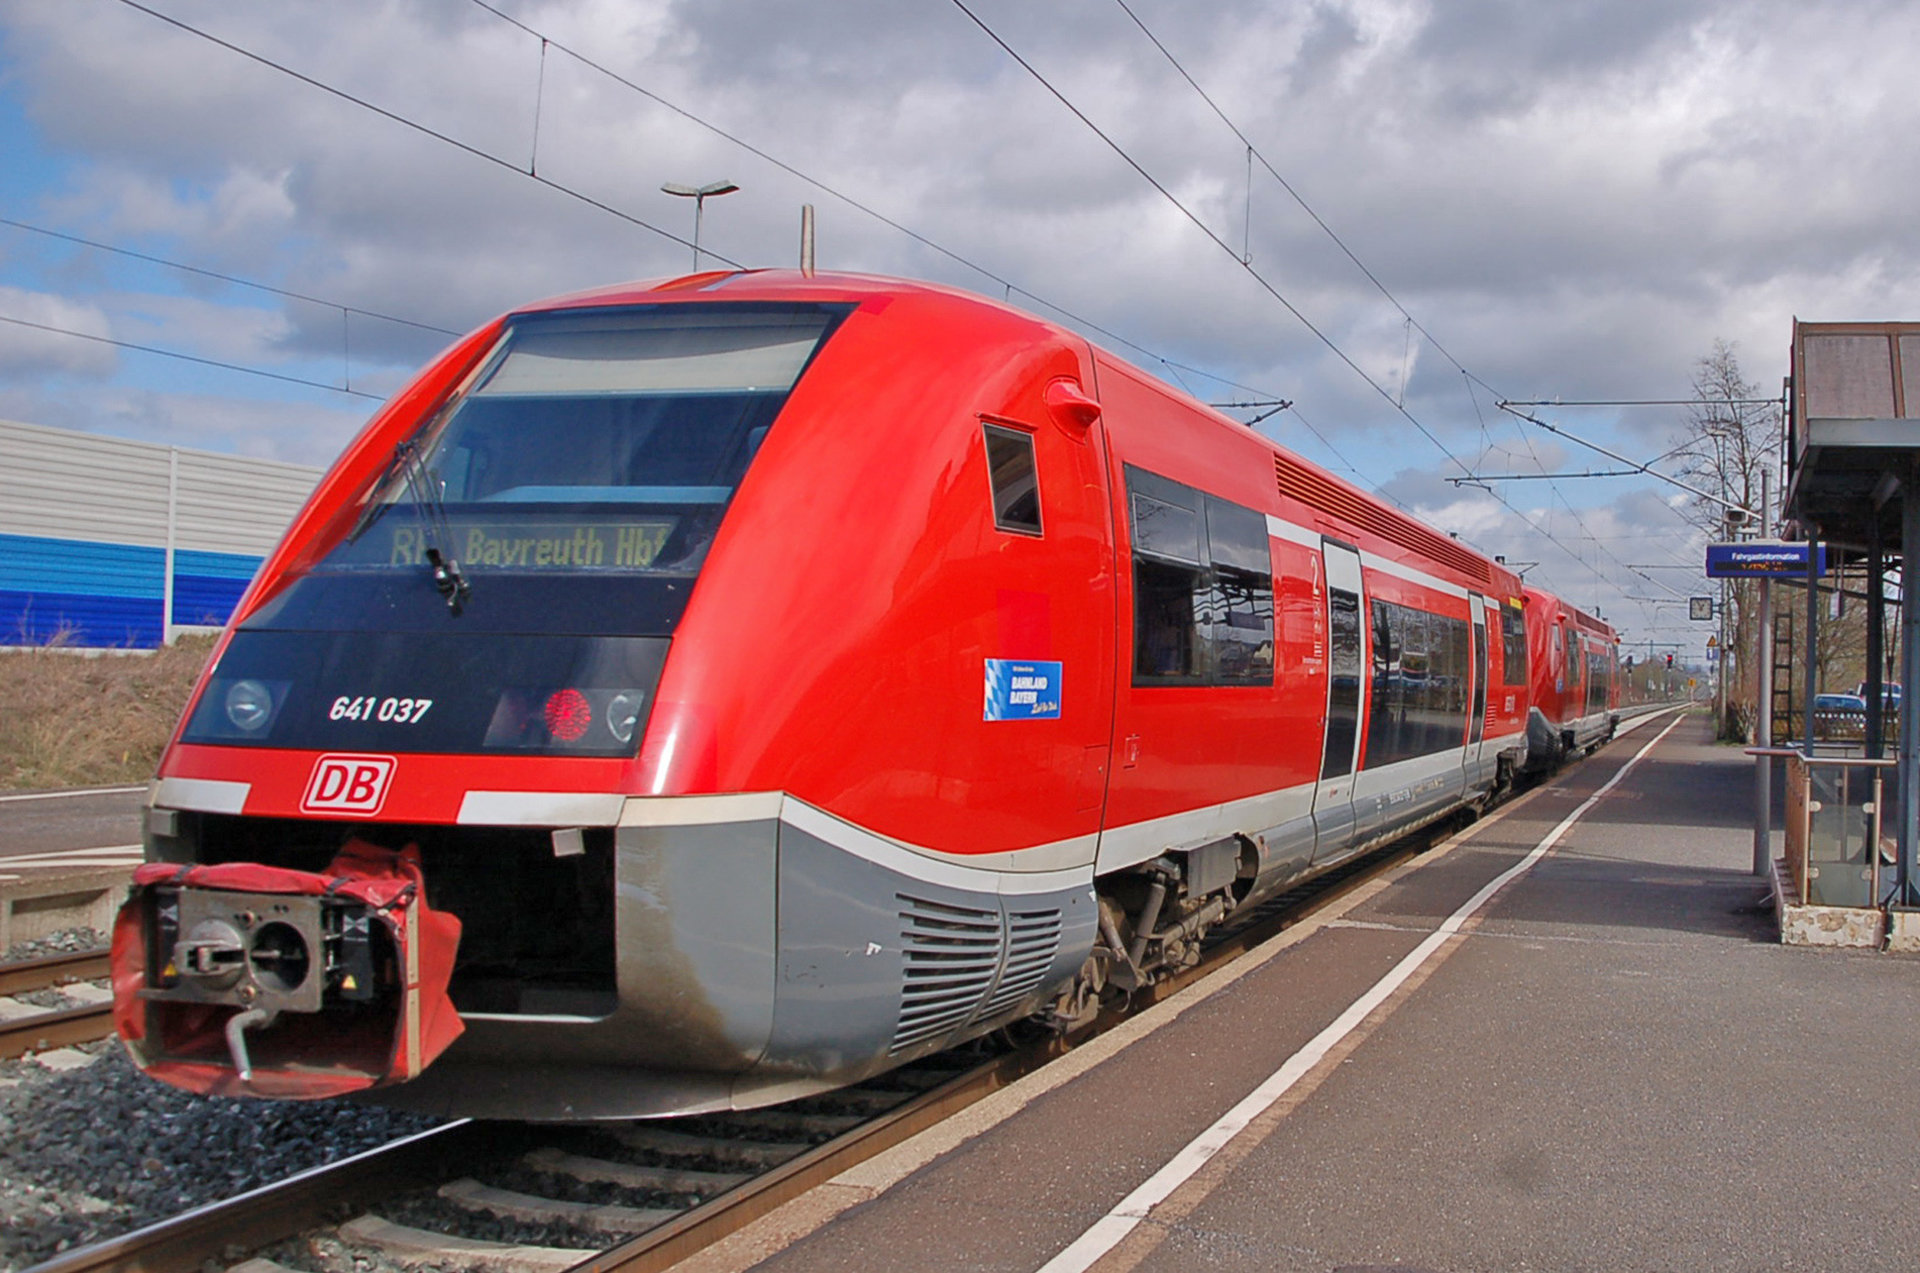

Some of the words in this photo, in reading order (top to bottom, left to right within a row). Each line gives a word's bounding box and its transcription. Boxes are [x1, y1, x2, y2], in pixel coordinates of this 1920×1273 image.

[466, 527, 604, 566] Bayreuth
[329, 696, 377, 720] 641
[378, 697, 433, 723] 037
[314, 764, 380, 803] DB
